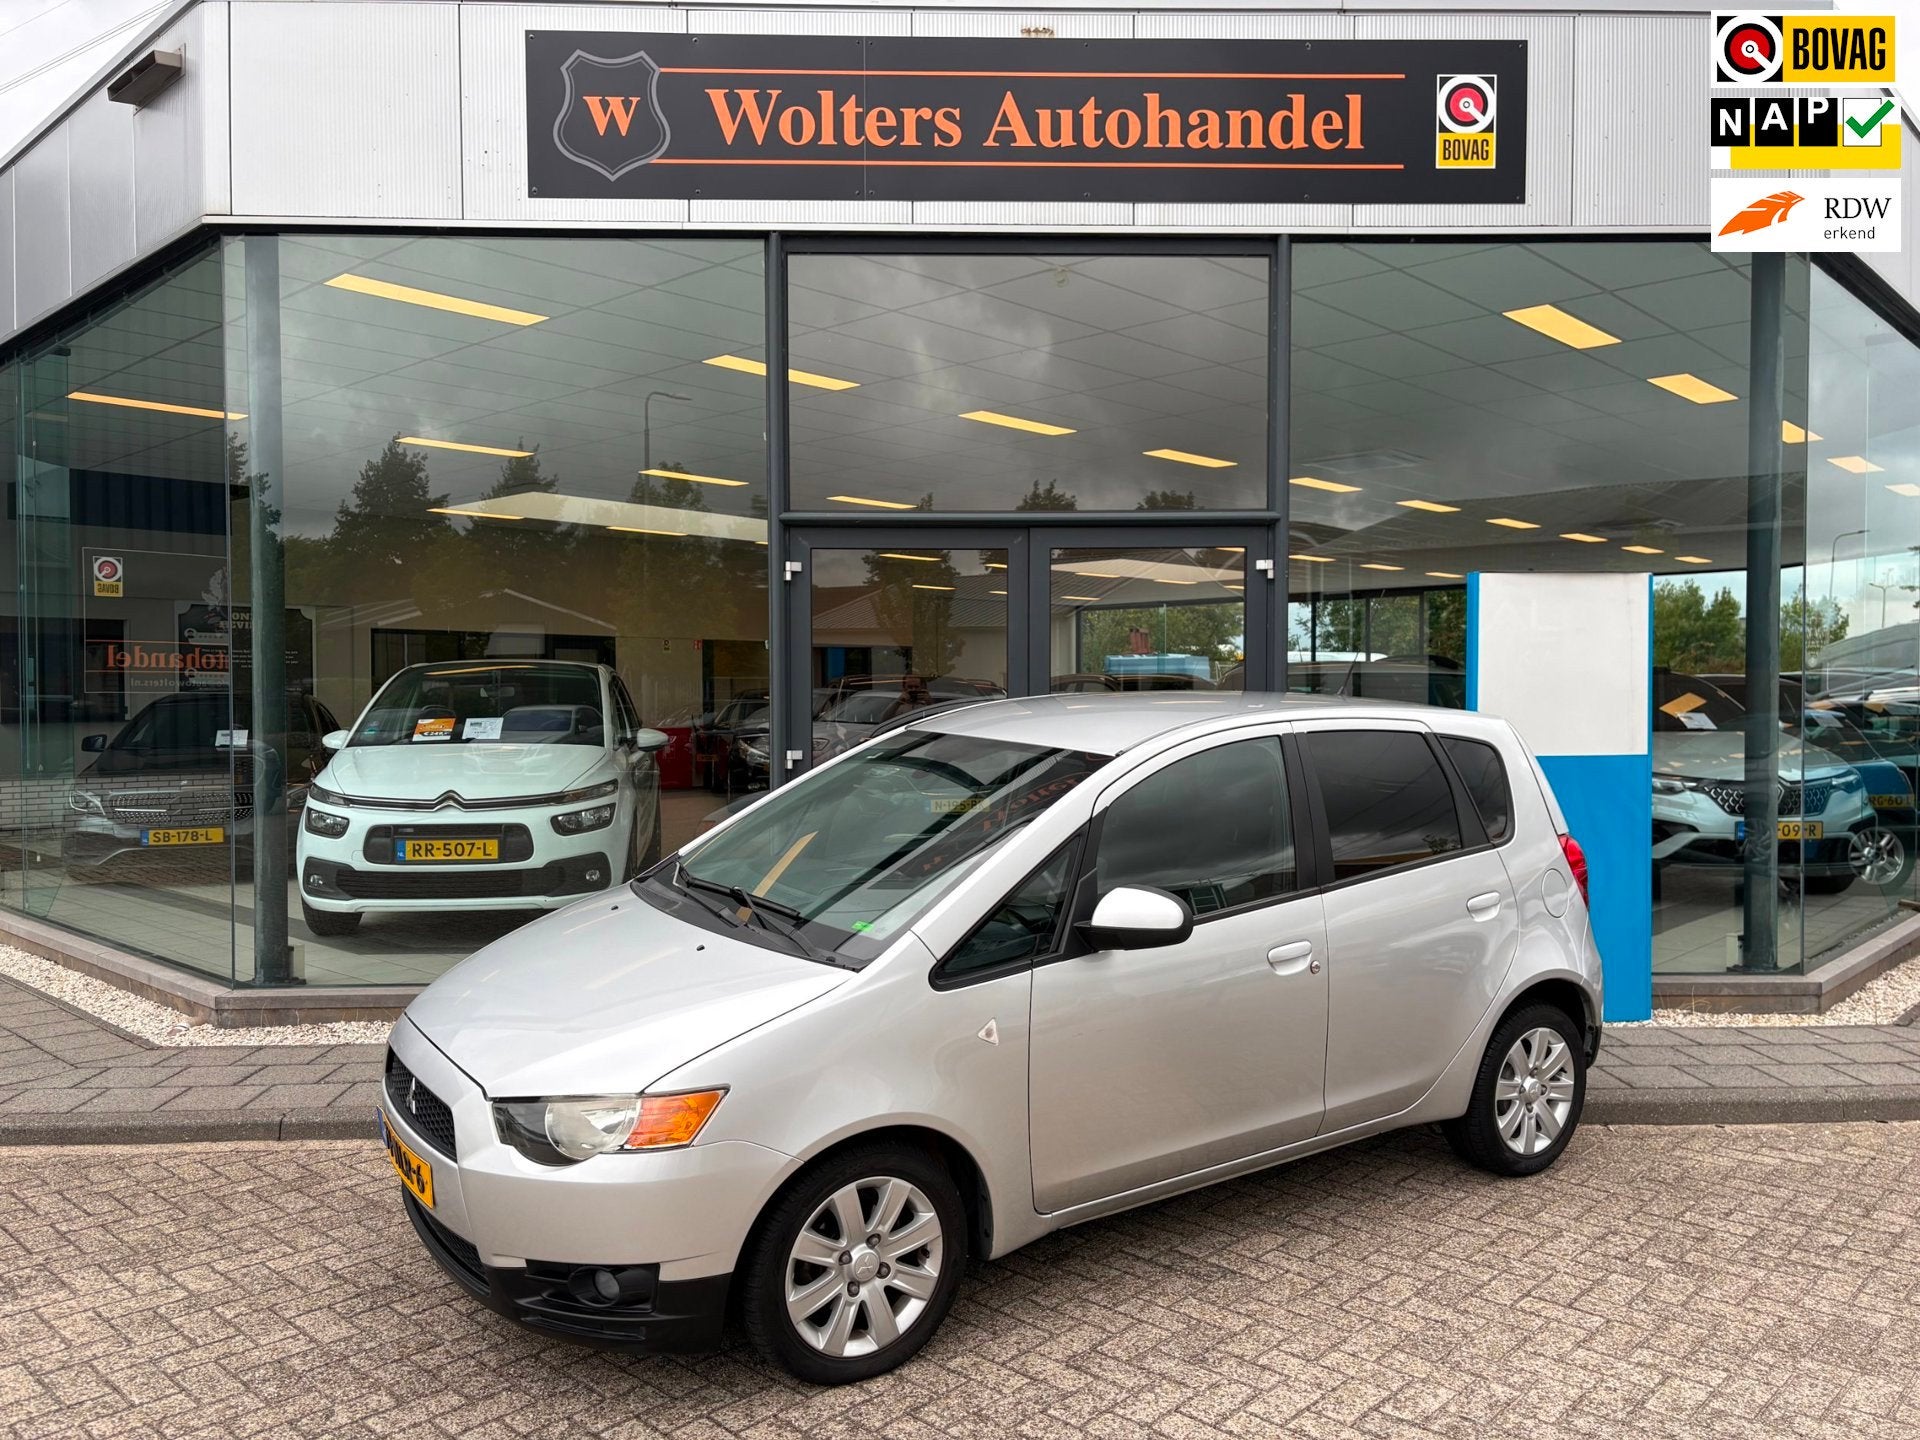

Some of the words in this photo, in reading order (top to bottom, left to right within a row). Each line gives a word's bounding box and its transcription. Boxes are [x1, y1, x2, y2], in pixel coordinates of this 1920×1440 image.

[582, 95, 641, 137] W
[704, 88, 962, 148] Wolters
[982, 89, 1365, 150] Autohandel
[1442, 138, 1490, 161] BOVAG
[153, 830, 213, 843] SB-178-L
[412, 842, 492, 858] RR-507-L
